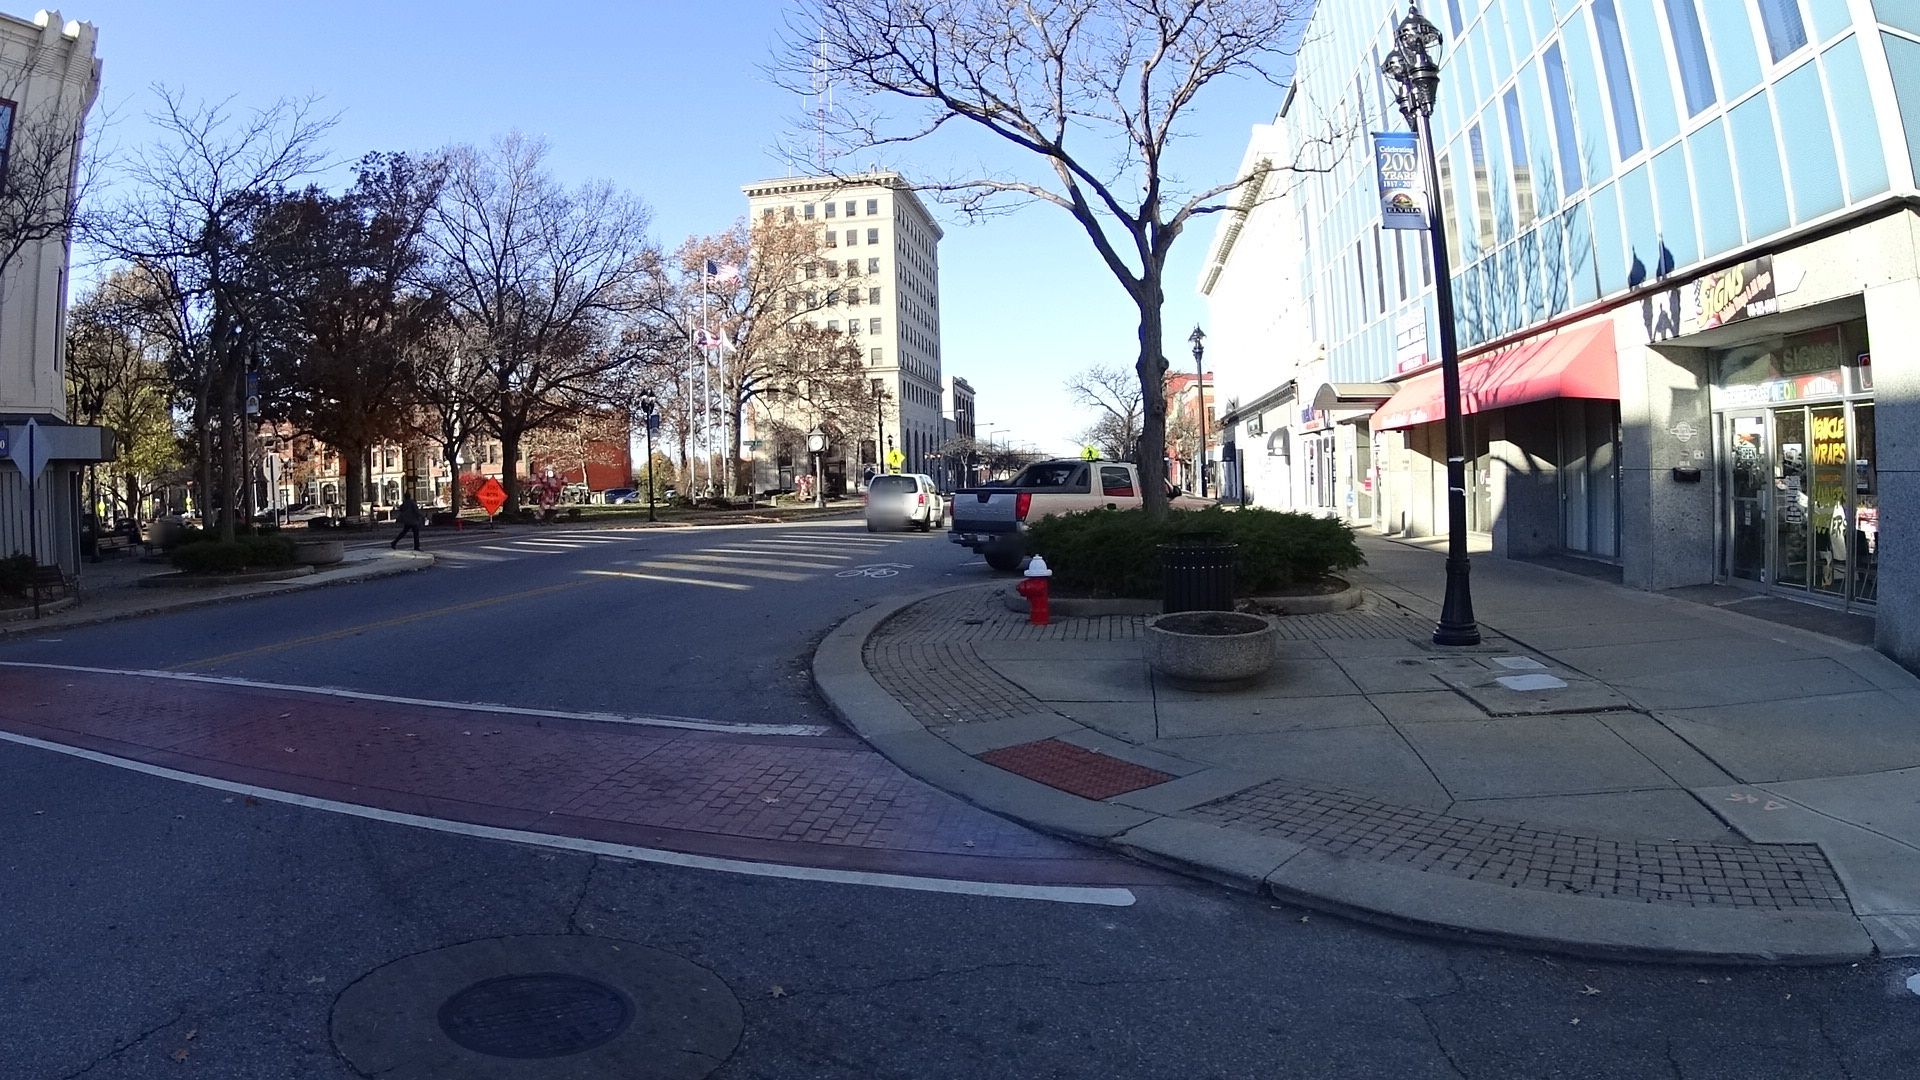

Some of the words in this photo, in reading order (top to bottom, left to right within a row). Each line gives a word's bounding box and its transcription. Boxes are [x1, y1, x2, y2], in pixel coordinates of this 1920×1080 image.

[1380, 152, 1415, 172] 200
[1697, 262, 1744, 328] SIGNS
[1771, 378, 1797, 402] NEON
[1813, 416, 1844, 441] VEHICLE
[1813, 443, 1847, 465] WRAPS
